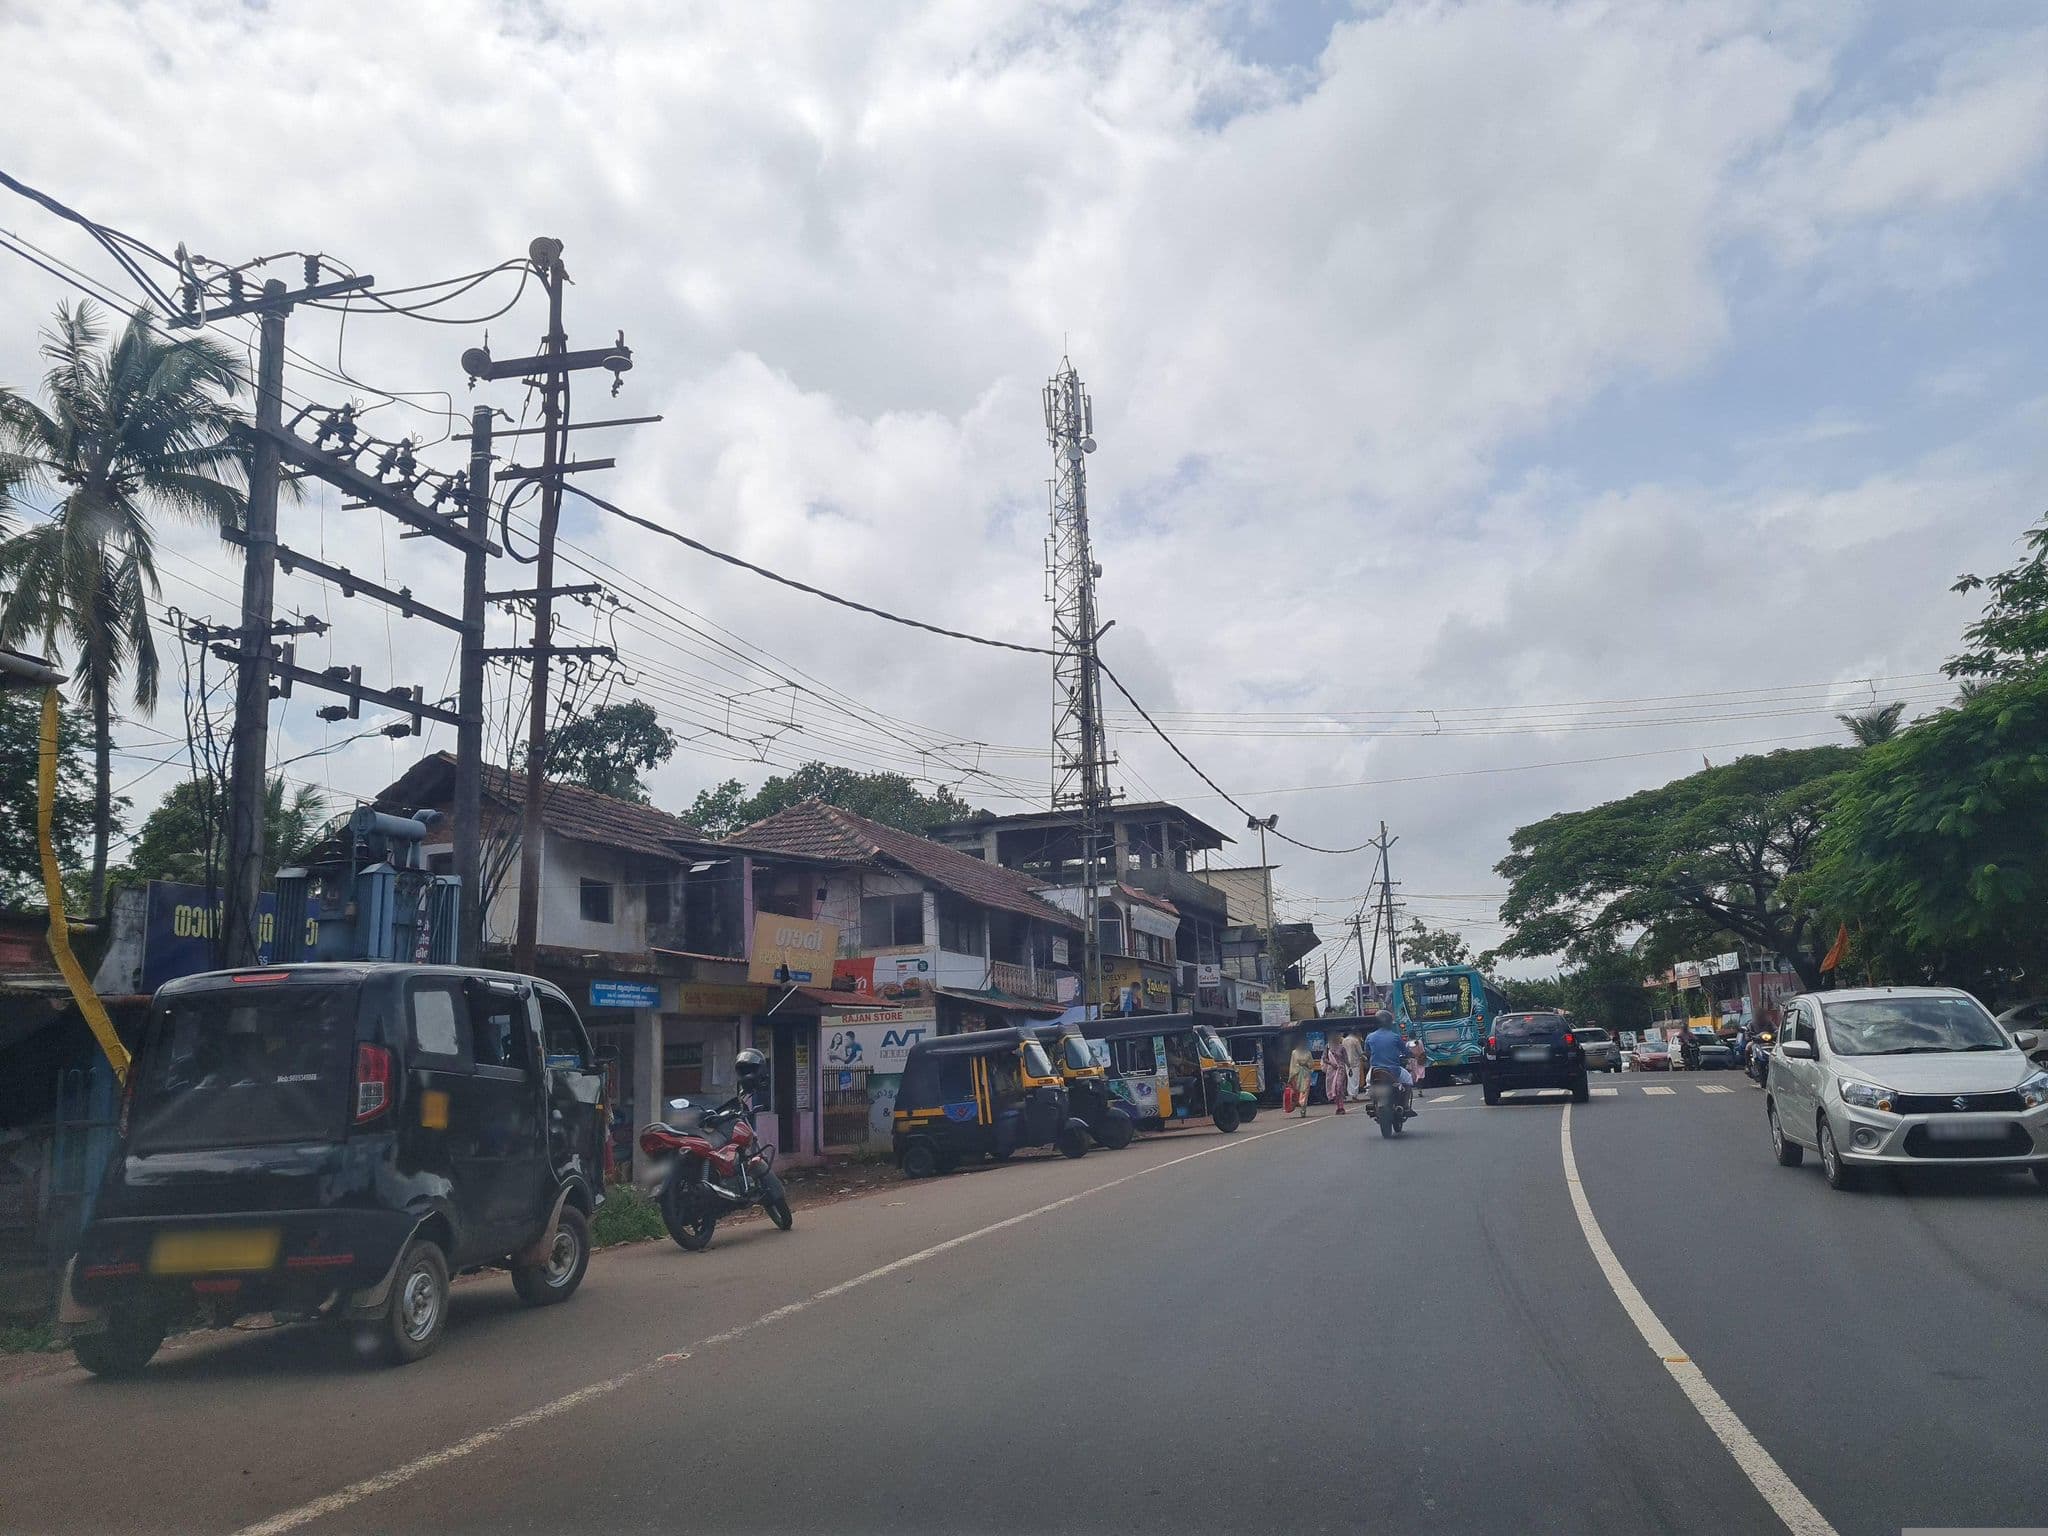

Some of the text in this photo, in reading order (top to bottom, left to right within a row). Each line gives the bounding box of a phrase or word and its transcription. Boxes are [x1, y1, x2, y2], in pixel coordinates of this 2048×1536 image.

[842, 1013, 872, 1023] RAJAN
[873, 1011, 903, 1021] STORE
[881, 1028, 926, 1047] AVT
[882, 1108, 891, 1117] &
